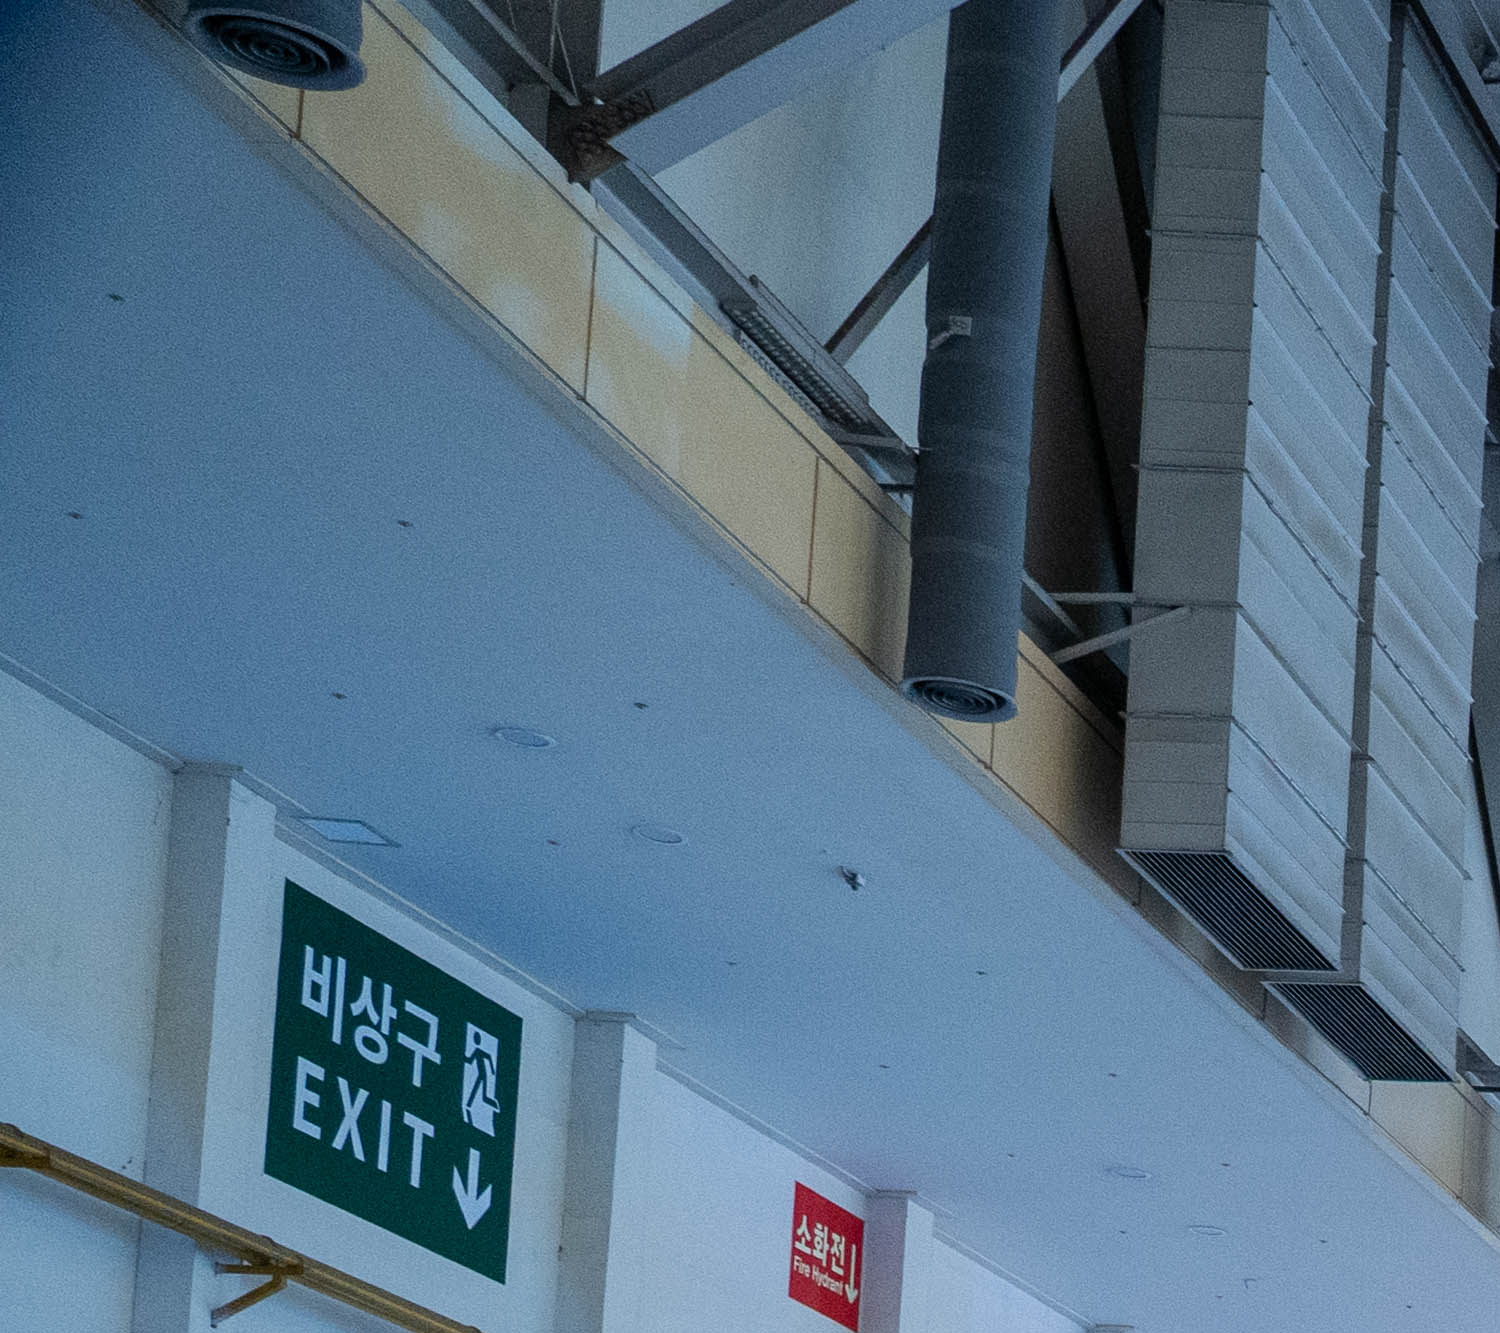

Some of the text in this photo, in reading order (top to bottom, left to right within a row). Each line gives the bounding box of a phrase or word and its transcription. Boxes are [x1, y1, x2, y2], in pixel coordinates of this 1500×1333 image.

[301, 945, 441, 1087] 비상구
[292, 1056, 434, 1188] EXIT
[793, 1255, 844, 1296] Fire Hydrant
[794, 1214, 845, 1276] 소화전
